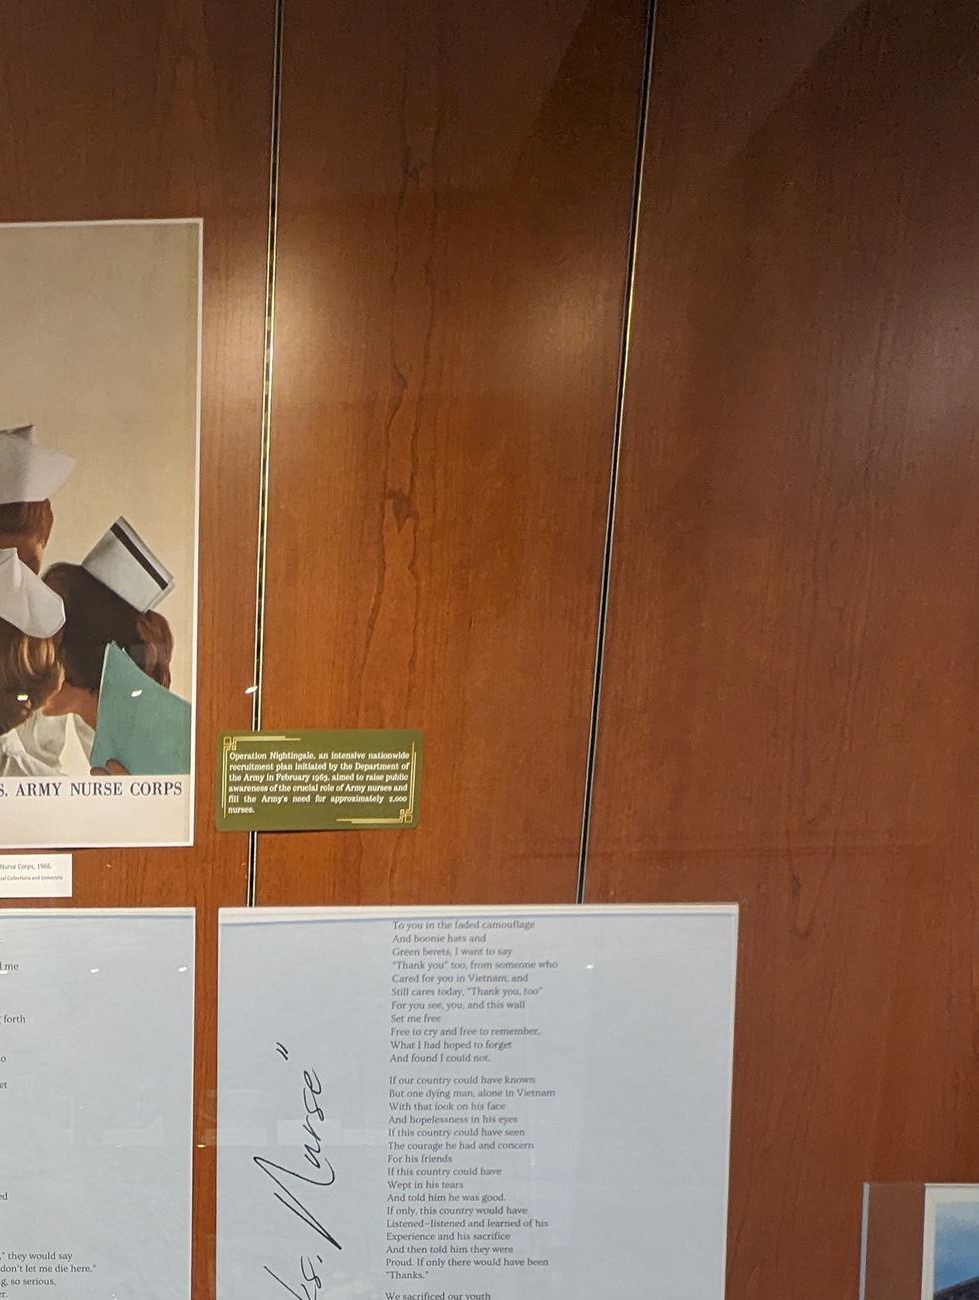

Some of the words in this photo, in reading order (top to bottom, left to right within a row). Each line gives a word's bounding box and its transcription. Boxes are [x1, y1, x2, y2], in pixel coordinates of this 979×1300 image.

[229, 751, 267, 761] Operation
[318, 752, 329, 760] an
[368, 751, 410, 760] nationwide
[16, 782, 62, 797] ARMY
[70, 782, 123, 796] NURSE
[130, 781, 182, 796] CORPS
[3, 1014, 26, 1024] forth
[384, 1292, 401, 1300] We
[402, 1291, 446, 1300] sacrificed
